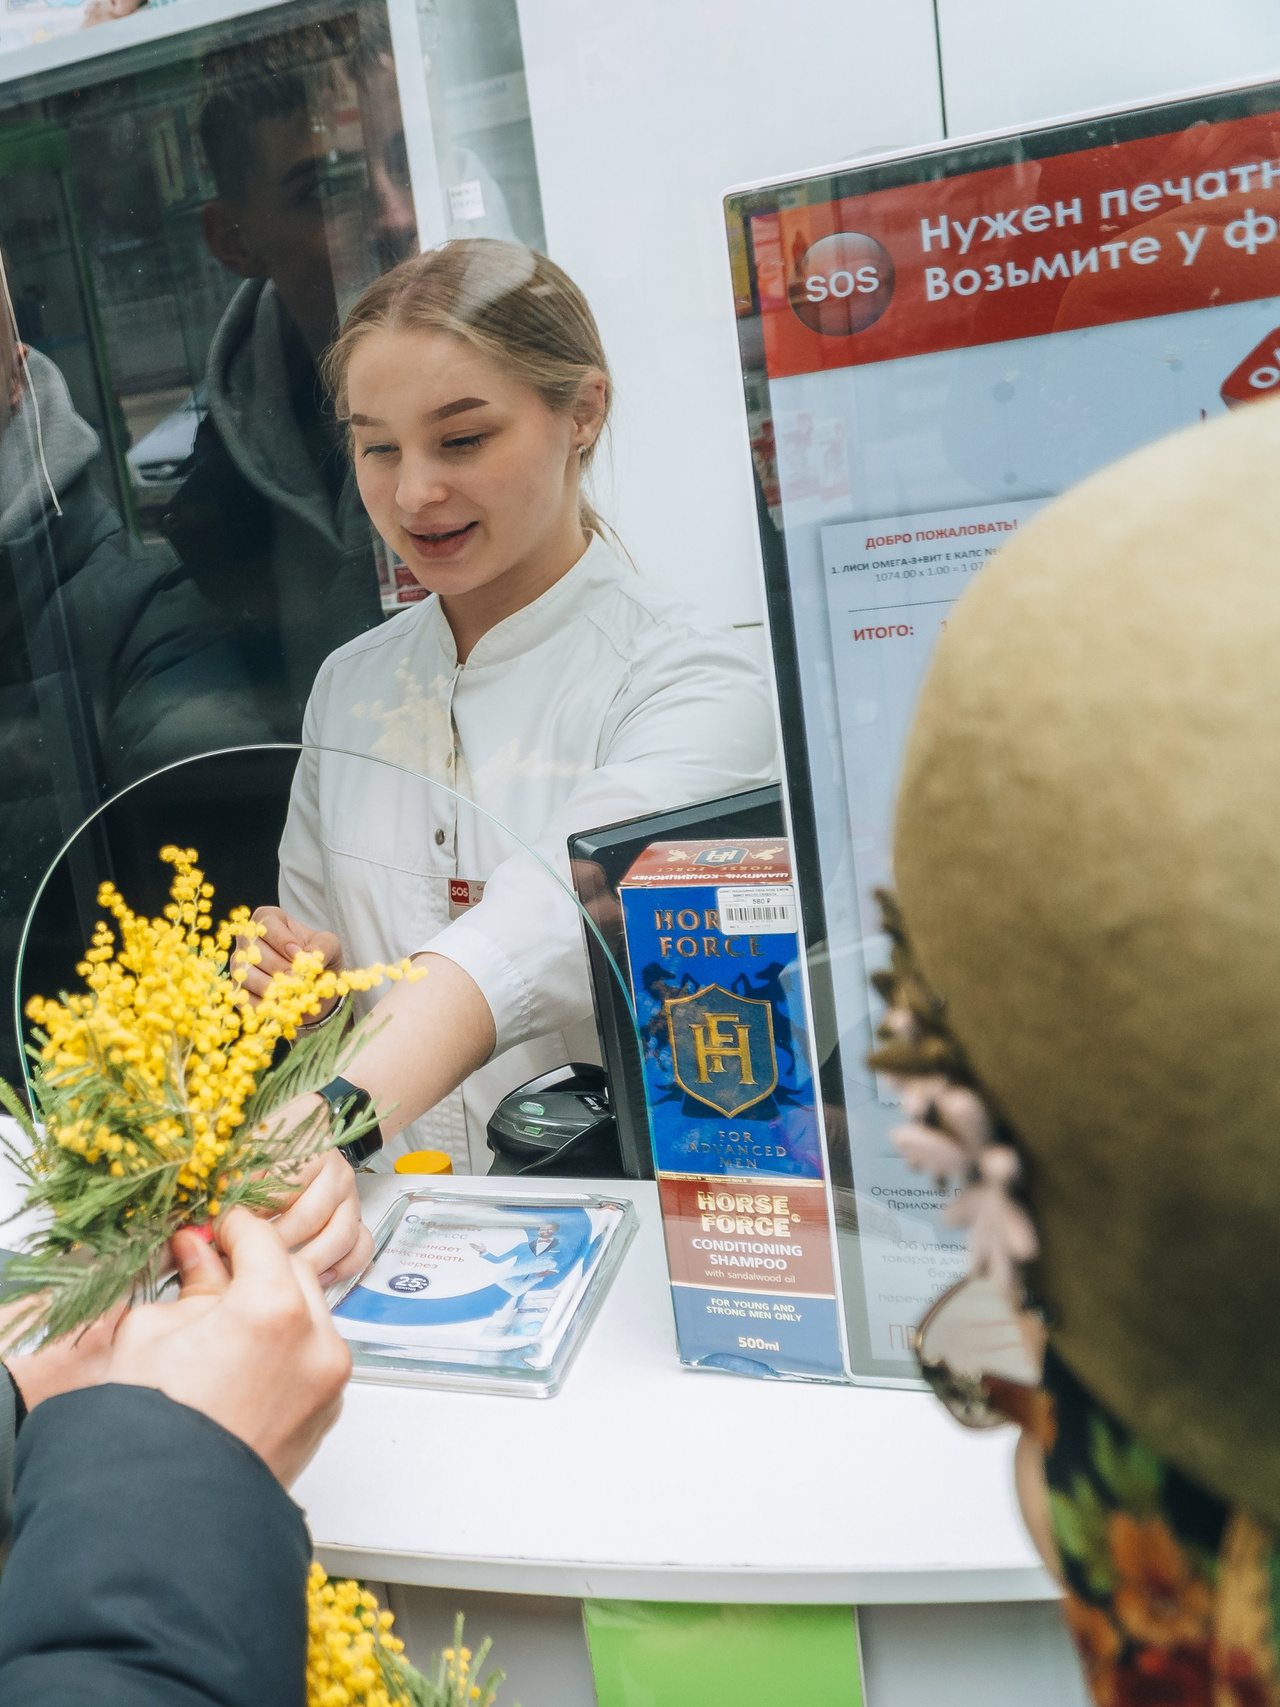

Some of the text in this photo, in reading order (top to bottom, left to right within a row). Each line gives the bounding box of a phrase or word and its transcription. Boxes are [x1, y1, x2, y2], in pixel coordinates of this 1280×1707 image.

[920, 197, 1083, 255] Нужен
[925, 236, 1163, 303] Возьмите
[1176, 225, 1209, 267] у
[805, 266, 880, 303] SOS
[865, 519, 1019, 551] ДОБРО ПОЖАЛОВАТЬ!
[832, 566, 841, 574] 1.
[842, 563, 870, 574] ЛИСИ
[872, 554, 942, 570] ОМЕГА-3+ВИТ
[954, 549, 982, 560] КАПС
[875, 565, 951, 582] 1074.00 1.00
[853, 624, 915, 642] ИТОГО:
[631, 872, 789, 881] ШАМПУНЬ-КОНДИЦИОНЕР
[451, 886, 469, 897] SOS
[659, 936, 766, 958] FORCE
[718, 1131, 754, 1143] FOR
[686, 1142, 787, 1158] ADVANCED
[719, 1158, 758, 1169] MEN
[871, 1186, 950, 1198] Основание:
[697, 1191, 790, 1216] HORSE
[700, 1214, 791, 1238] FORCE
[691, 1238, 803, 1257] CONDITIONING
[709, 1254, 788, 1271] SHAMPOO
[705, 1269, 796, 1285] with sandalwood oil
[711, 1297, 795, 1313] FOR YOUNG AND
[706, 1306, 802, 1323] STRONG MEN ONLY
[738, 1336, 780, 1352] 500ml
